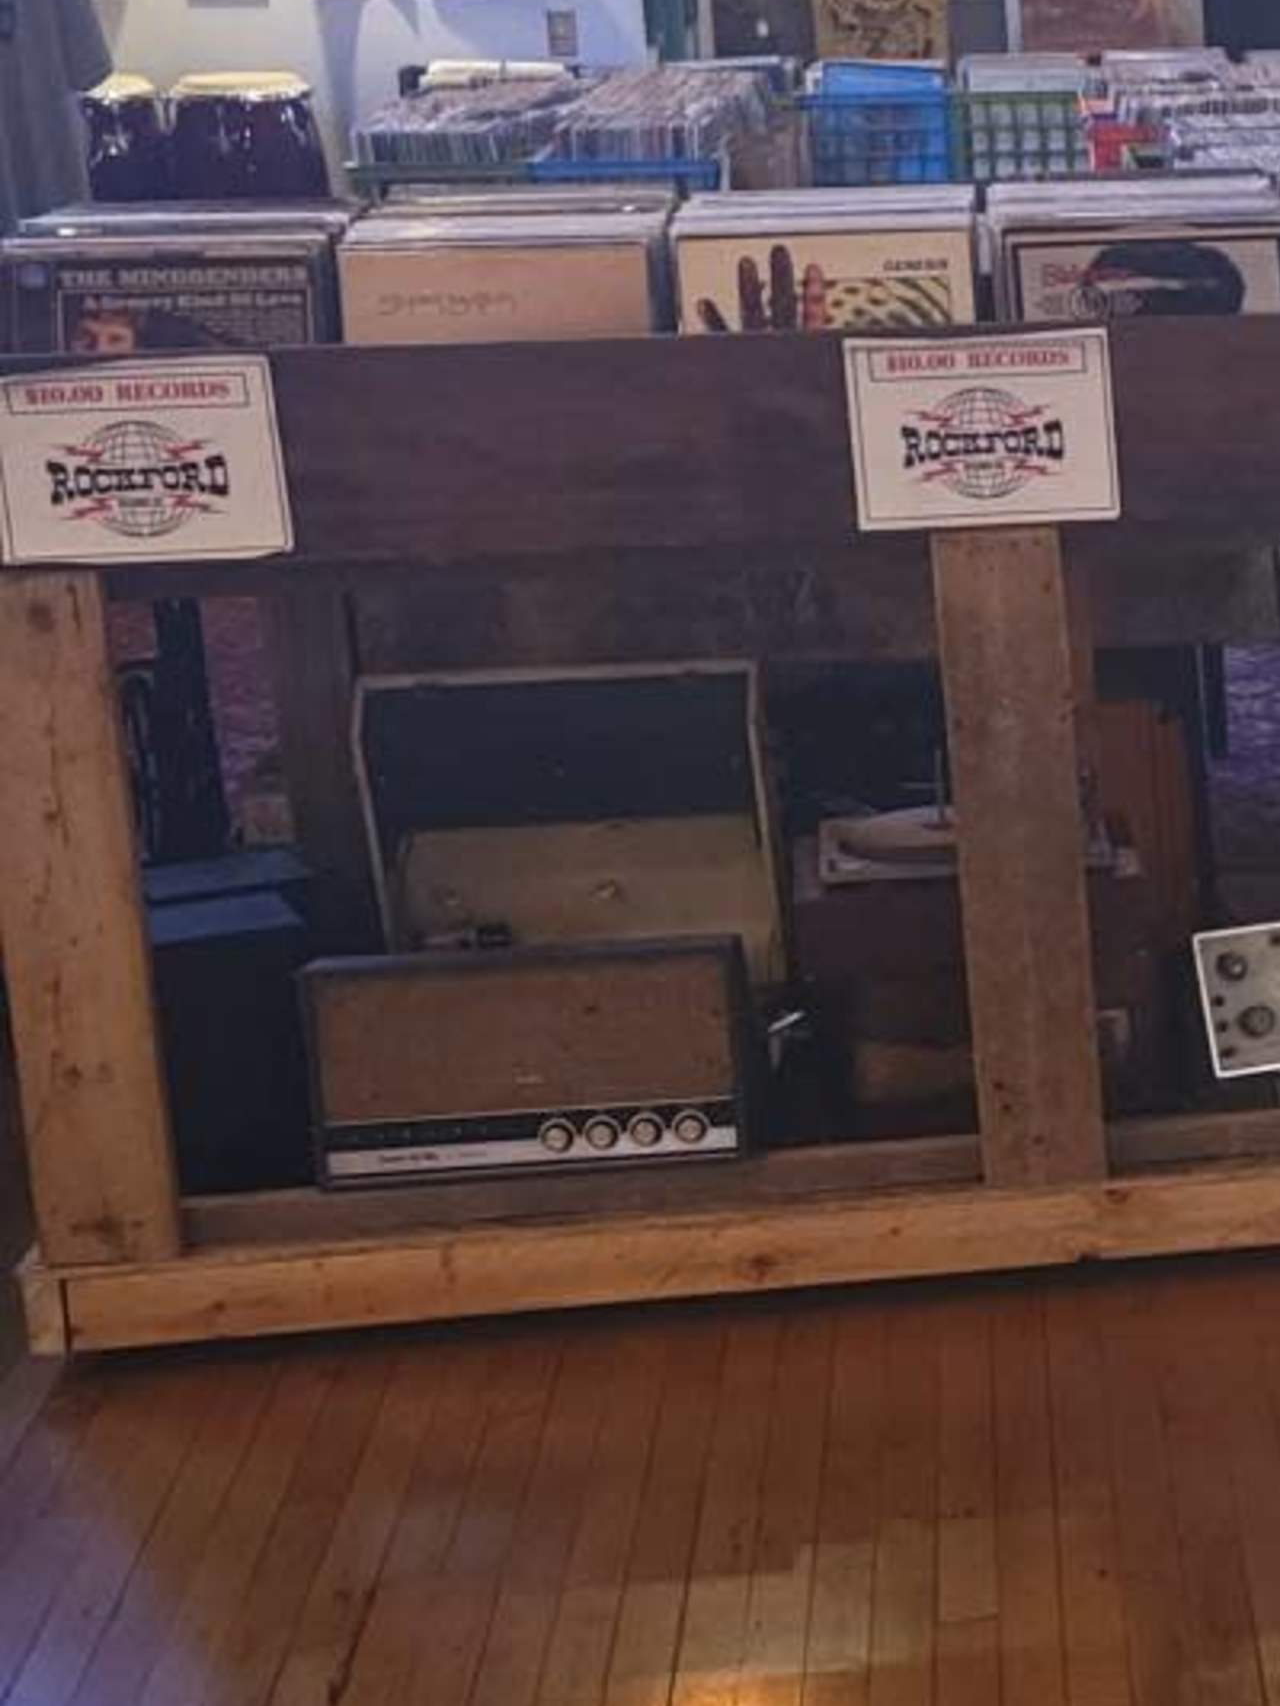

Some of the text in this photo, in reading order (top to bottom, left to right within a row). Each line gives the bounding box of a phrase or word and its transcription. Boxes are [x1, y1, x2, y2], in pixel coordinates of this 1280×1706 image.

[966, 349, 1070, 370] RECORDS
[115, 381, 231, 402] RECORDS
[900, 419, 1065, 468] ROCKFORD
[46, 455, 230, 505] ROCKFORD
